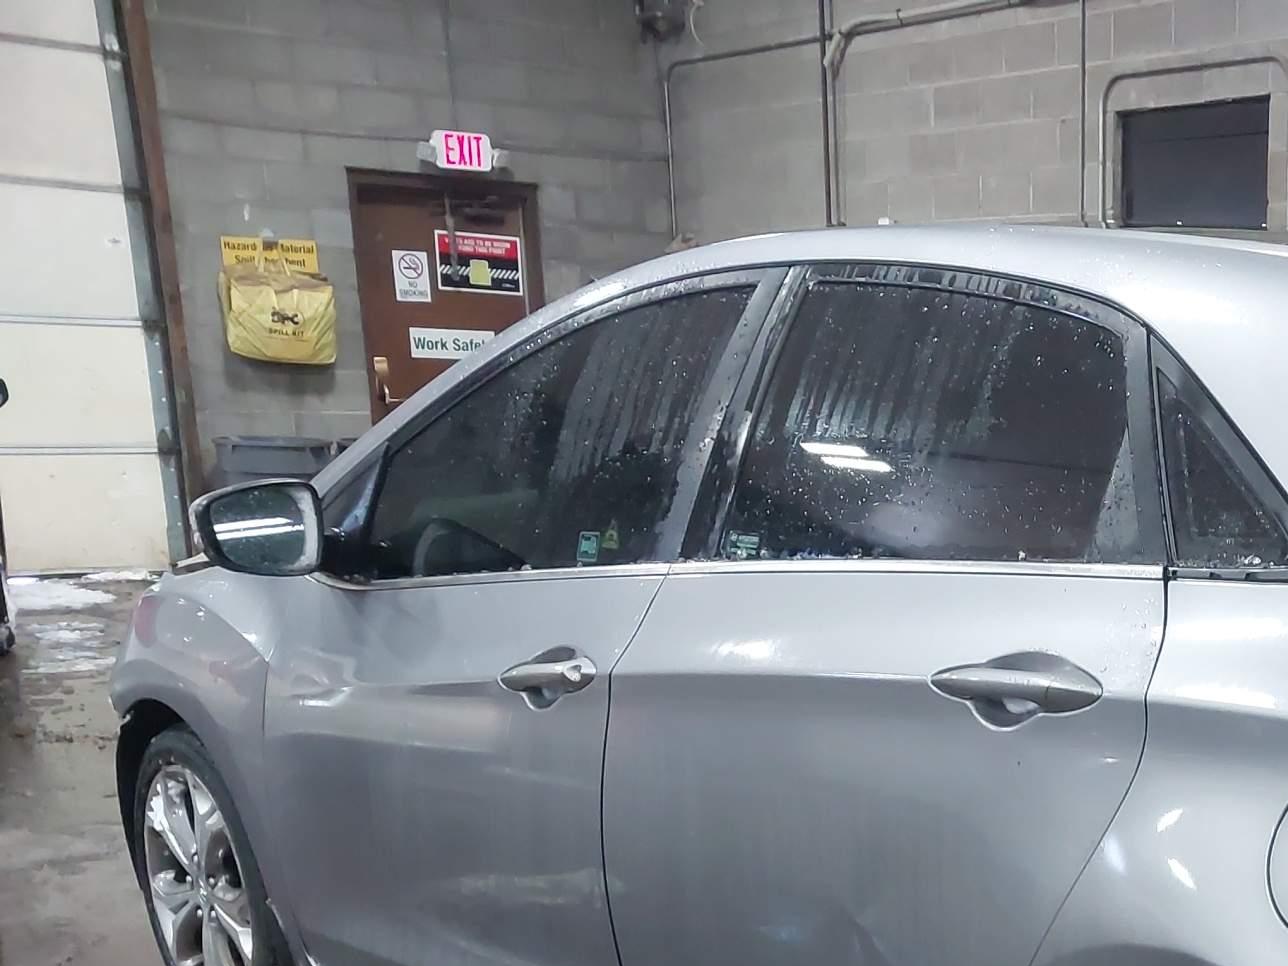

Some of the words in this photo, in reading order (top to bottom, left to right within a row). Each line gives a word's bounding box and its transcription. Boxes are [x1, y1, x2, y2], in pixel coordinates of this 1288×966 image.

[444, 133, 482, 167] EXIT
[408, 280, 418, 289] NO
[399, 288, 428, 297] SMOKING
[269, 328, 289, 336] SPILL
[292, 329, 305, 337] KIT
[413, 336, 449, 350] Work
[452, 338, 485, 351] Safe
